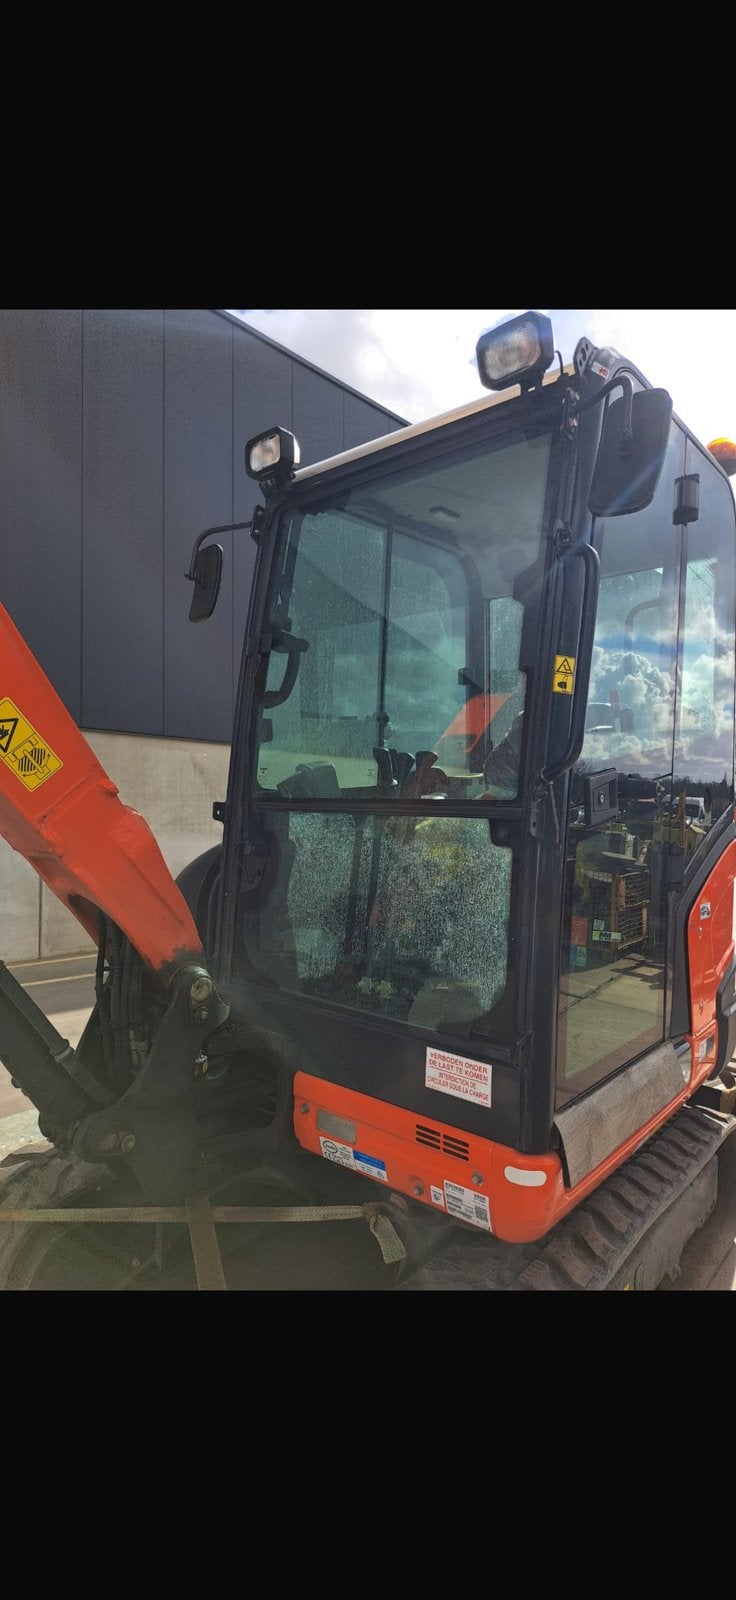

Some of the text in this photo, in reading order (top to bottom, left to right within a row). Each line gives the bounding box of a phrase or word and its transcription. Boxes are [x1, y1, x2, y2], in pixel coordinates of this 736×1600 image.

[430, 1051, 488, 1074] VERBODEN ONDER
[438, 1062, 454, 1073] LAST
[464, 1070, 488, 1082] KOMEN
[427, 1076, 449, 1087] CIRCULER
[449, 1082, 462, 1092] SOUS
[469, 1089, 489, 1101] CHARGE
[438, 1072, 469, 1087] INTERDICTION
[469, 1081, 477, 1089] DE
